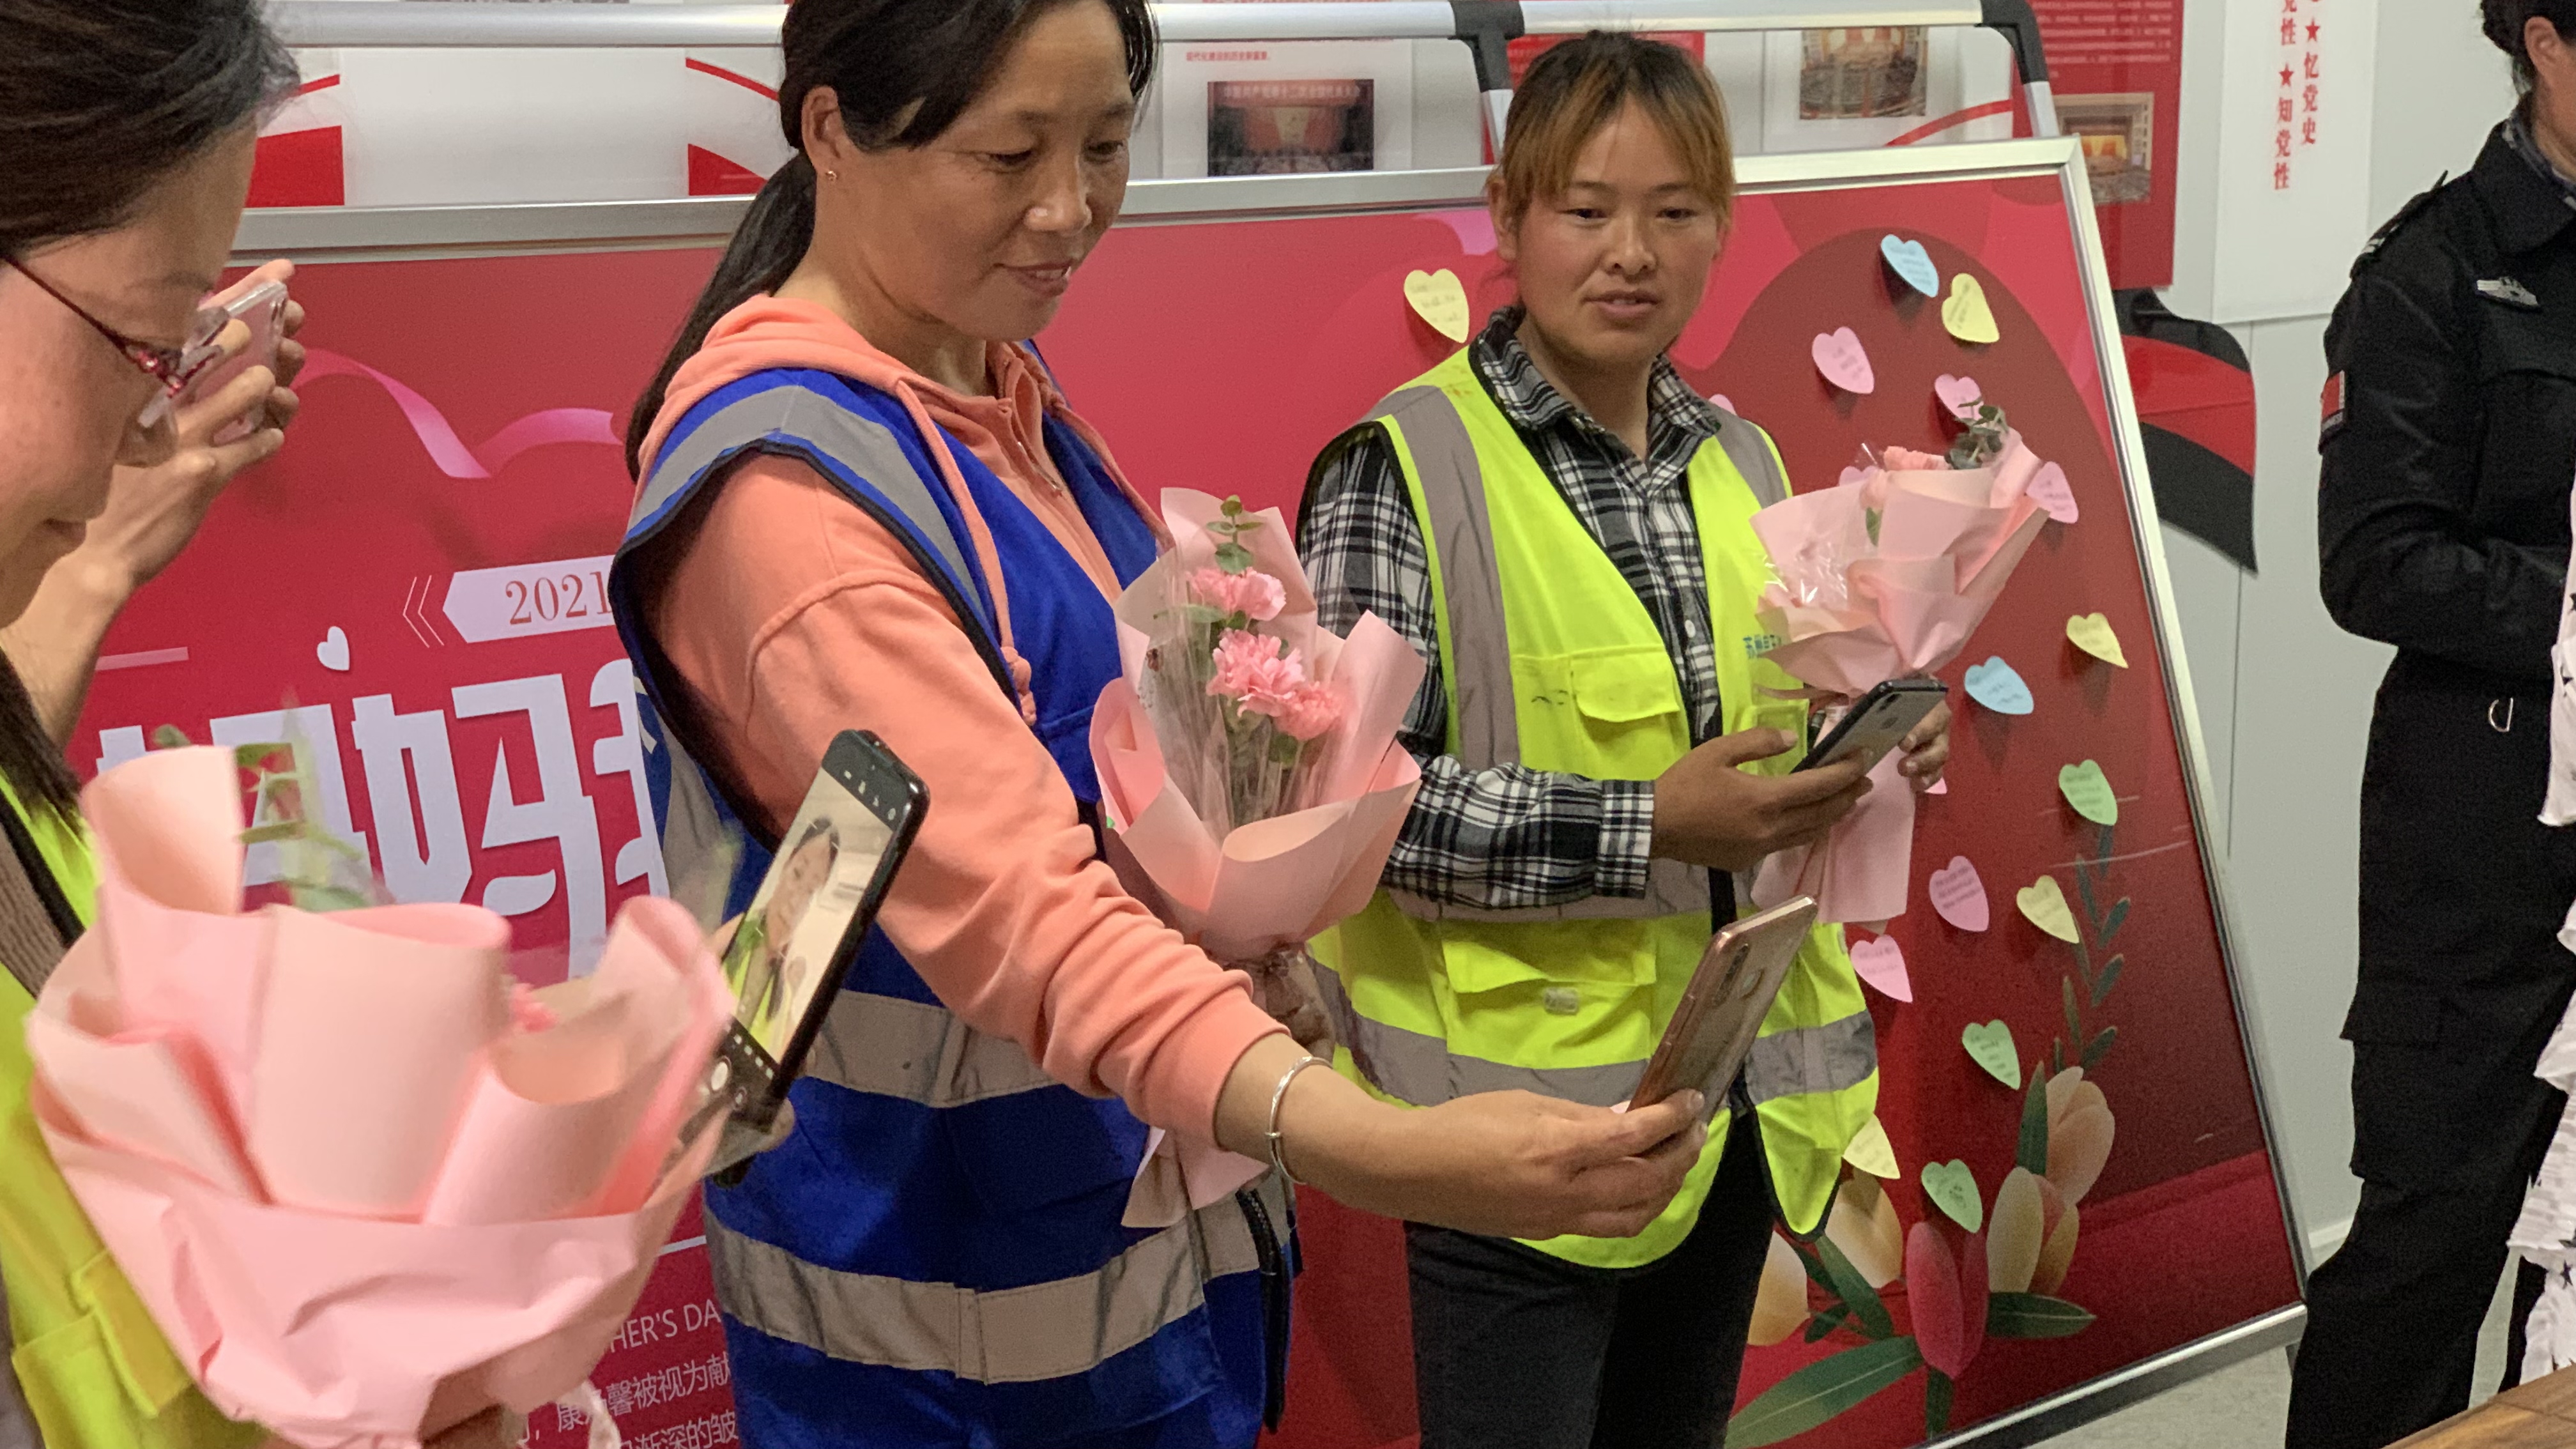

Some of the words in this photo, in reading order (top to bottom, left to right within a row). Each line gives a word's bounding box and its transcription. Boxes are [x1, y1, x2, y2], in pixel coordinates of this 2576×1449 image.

[2274, 97, 2292, 190] 知党性
[2301, 52, 2319, 145] 忆党史
[505, 571, 612, 625] 2021
